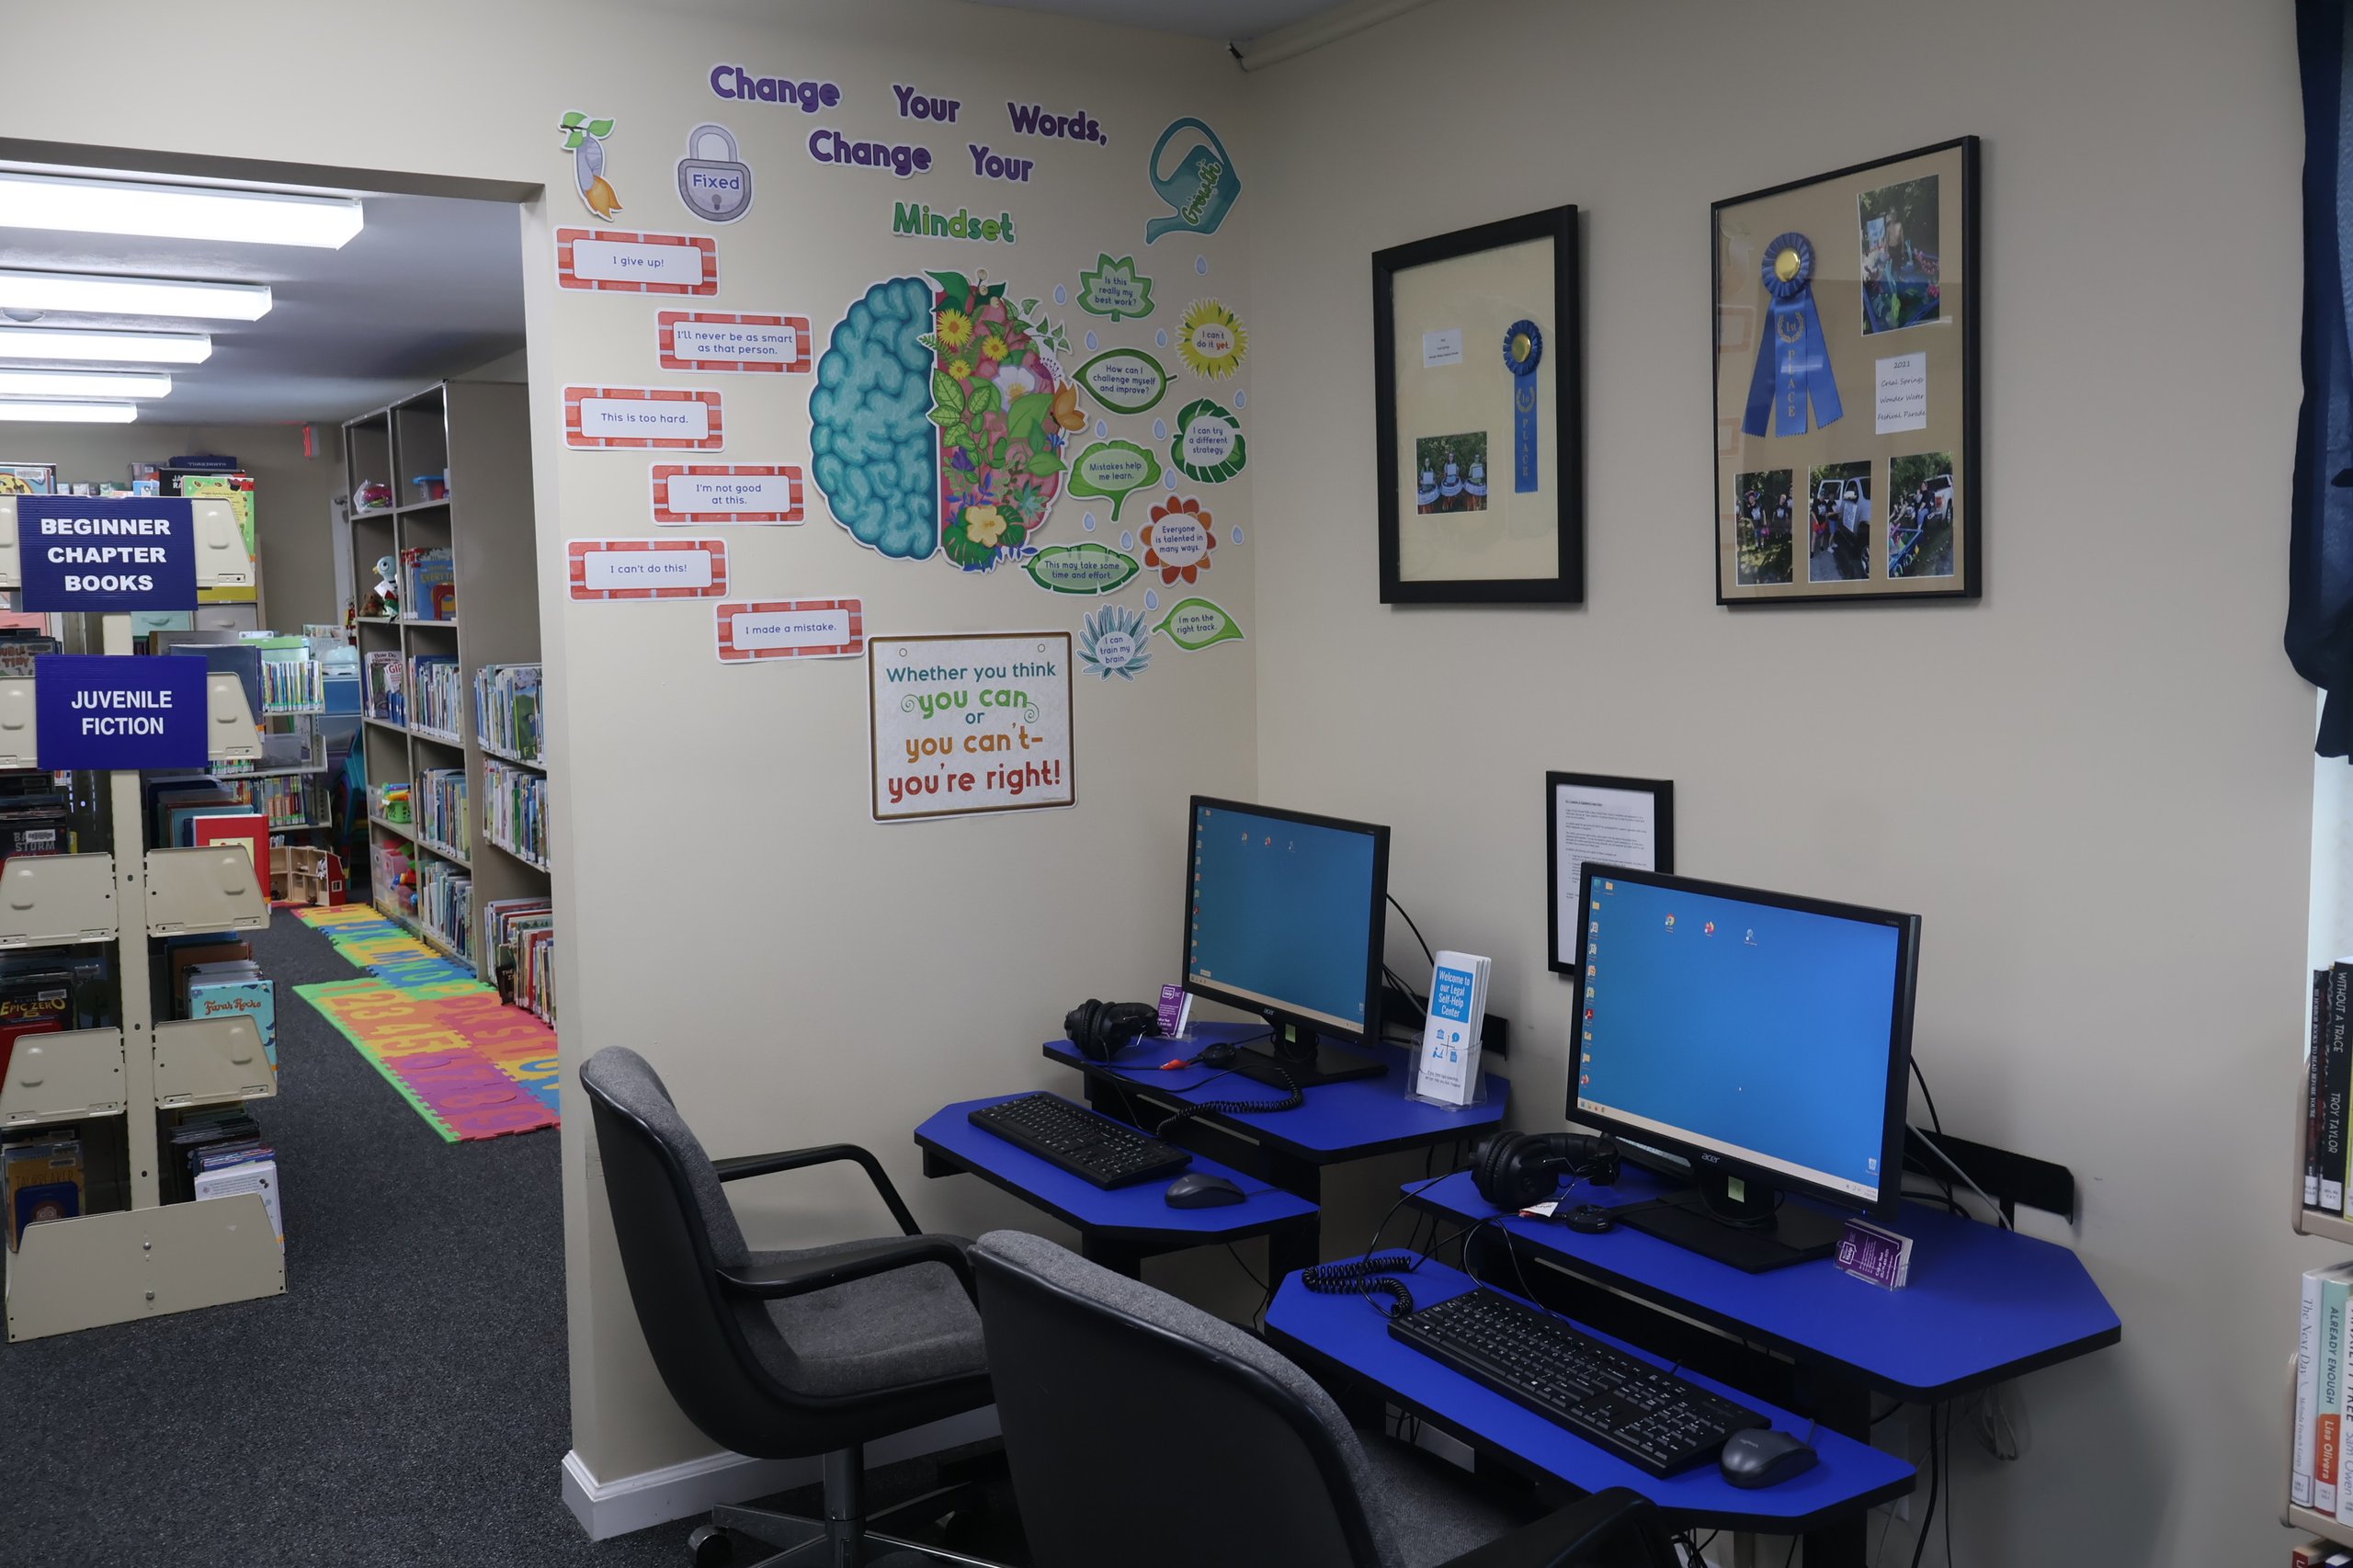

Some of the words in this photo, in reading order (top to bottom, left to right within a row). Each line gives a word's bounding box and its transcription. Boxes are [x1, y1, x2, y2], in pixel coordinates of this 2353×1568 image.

[710, 65, 841, 114] Change
[893, 85, 961, 123] Your
[1007, 102, 1108, 146] Words,
[809, 130, 932, 176] Change
[968, 144, 1034, 182] Your
[693, 174, 740, 190] Fixed
[1181, 163, 1222, 225] Growth
[892, 202, 1015, 244] Mindset
[620, 256, 643, 267] give
[647, 258, 665, 268] up!
[1105, 277, 1111, 285] Is
[1113, 278, 1127, 286] this
[1099, 287, 1120, 296] really
[1122, 290, 1133, 298] my
[1095, 296, 1112, 304] best
[1114, 298, 1137, 307] work?
[677, 331, 692, 340] I'll
[695, 333, 725, 341] never
[730, 332, 743, 342] be
[746, 334, 758, 343] as
[762, 333, 792, 344] smart
[1207, 331, 1224, 339] can't
[698, 344, 710, 353] as
[714, 344, 735, 354] that
[738, 346, 778, 356] person.
[1209, 339, 1214, 348] it
[1216, 341, 1231, 350] yet.
[1106, 365, 1122, 374] How
[1125, 367, 1139, 375] can
[1093, 373, 1130, 384] challenge
[1132, 377, 1156, 386] myself
[1100, 385, 1114, 393] and
[1116, 385, 1149, 395] improve?
[601, 414, 624, 423] This
[627, 414, 636, 423] is
[640, 415, 657, 424] too
[660, 414, 688, 425] hard.
[1213, 427, 1223, 437] try
[1196, 436, 1228, 445] different
[1193, 446, 1225, 455] strategy.
[1089, 462, 1123, 472] Mistakes
[1125, 462, 1142, 472] help
[1098, 472, 1110, 481] me
[1112, 472, 1134, 481] learn.
[696, 484, 712, 493] I'm
[716, 484, 733, 493] not
[735, 483, 762, 494] good
[712, 496, 722, 506] at
[725, 495, 747, 506] this.
[40, 518, 172, 536] BEGINNER
[1162, 526, 1196, 535] Everyone
[1164, 534, 1195, 543] talented
[1197, 534, 1203, 542] in
[1160, 544, 1178, 554] many
[1181, 545, 1200, 553] ways.
[47, 547, 167, 564] CHAPTER
[618, 564, 644, 574] can't
[648, 564, 662, 574] do
[665, 563, 688, 574] this!
[1045, 561, 1061, 570] This
[1063, 562, 1078, 572] may
[1080, 562, 1098, 570] take
[1052, 571, 1070, 579] time
[1088, 571, 1113, 579] effort.
[64, 574, 154, 592] BOOKS
[1178, 616, 1189, 624] I'm
[1202, 614, 1214, 622] the
[753, 625, 781, 634] made
[784, 626, 790, 634] a
[794, 622, 836, 633] mistake.
[1176, 624, 1195, 634] right
[1196, 623, 1218, 632] track.
[1100, 646, 1118, 654] train
[1120, 646, 1131, 654] my
[1105, 655, 1127, 664] brain.
[886, 665, 969, 683] Whether
[973, 665, 1006, 683] you
[1012, 662, 1057, 678] think
[71, 690, 173, 710] JUVENILE
[918, 690, 969, 720] you
[979, 689, 1028, 708] can
[965, 712, 985, 724] or
[82, 717, 165, 735] FICTION
[906, 737, 953, 764] you
[888, 763, 976, 804] you're
[987, 759, 1061, 795] right!
[1439, 971, 1463, 985] Welcome
[1464, 976, 1471, 986] to
[1440, 984, 1450, 993] our
[1450, 984, 1465, 996] Legal
[2336, 971, 2347, 1014] WITHOUT
[1438, 993, 1464, 1009] Self-Help
[1441, 1006, 1461, 1018] Center
[2333, 1024, 2345, 1053] TRACE
[2330, 1093, 2341, 1118] TROY
[2328, 1119, 2339, 1154] TAYLOR
[1701, 1153, 1721, 1164] acer
[2302, 1299, 2313, 1320] The
[2302, 1325, 2313, 1350] Next
[2329, 1306, 2339, 1357] ALREADY
[2326, 1358, 2337, 1405] ENOUGH
[2325, 1420, 2335, 1441] Lisa
[2323, 1444, 2334, 1480] Olivera
